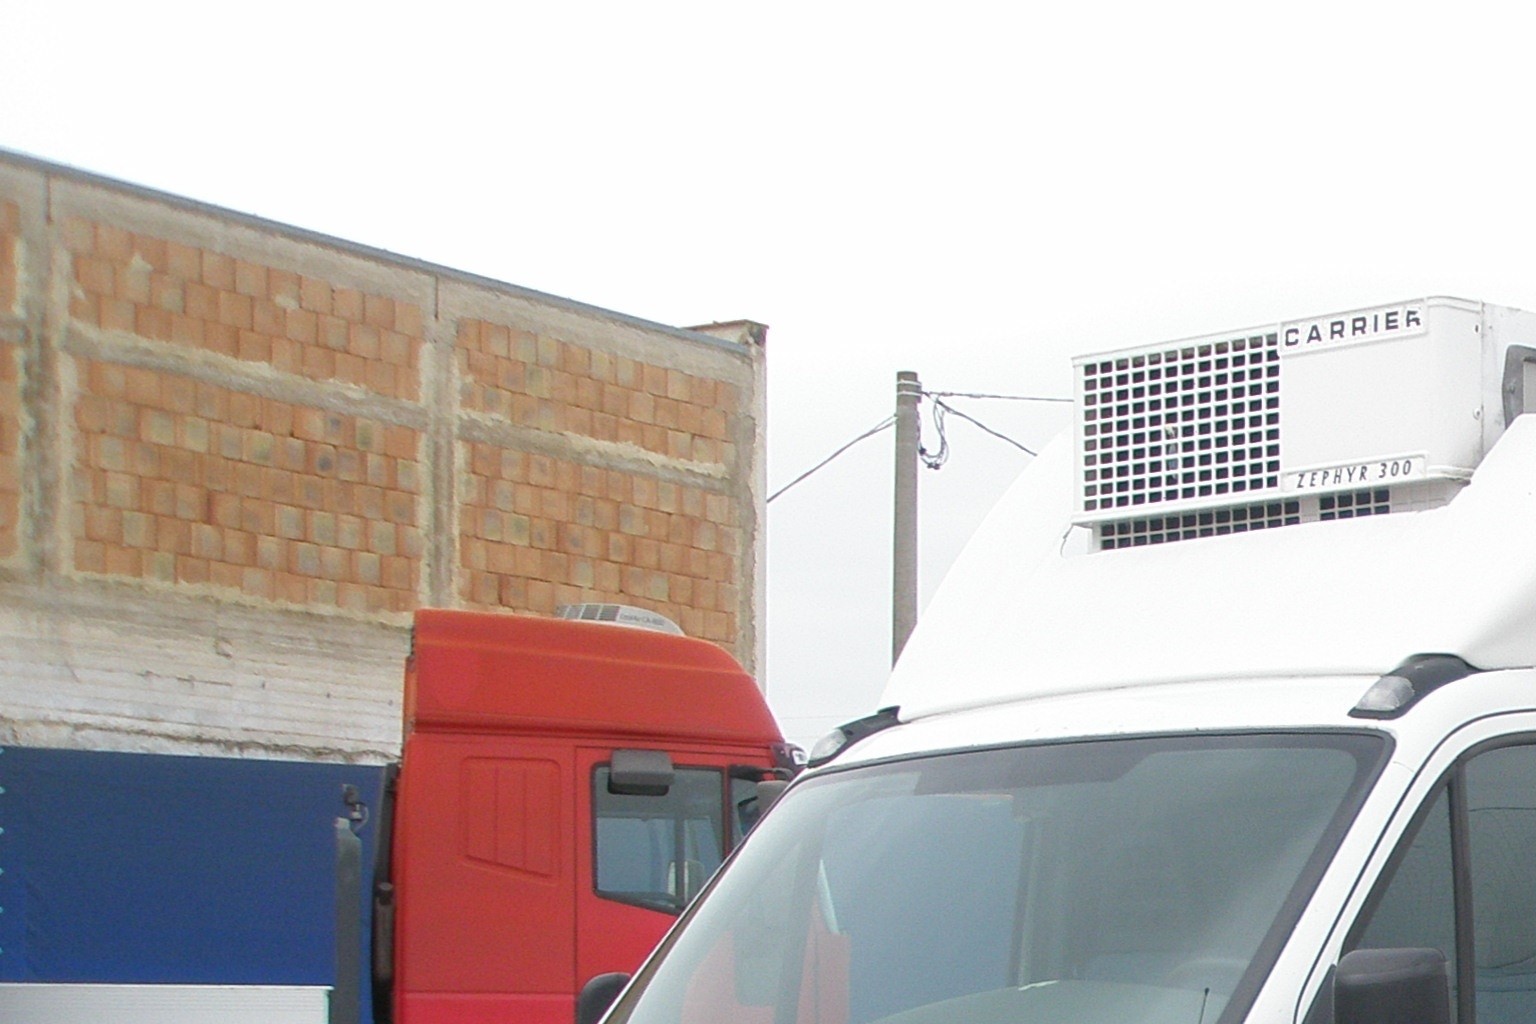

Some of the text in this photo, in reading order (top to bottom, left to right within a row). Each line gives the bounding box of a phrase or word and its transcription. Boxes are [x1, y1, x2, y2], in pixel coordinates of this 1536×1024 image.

[1285, 309, 1421, 347] CARRIER
[1296, 459, 1412, 488] ZEPHYR 300
